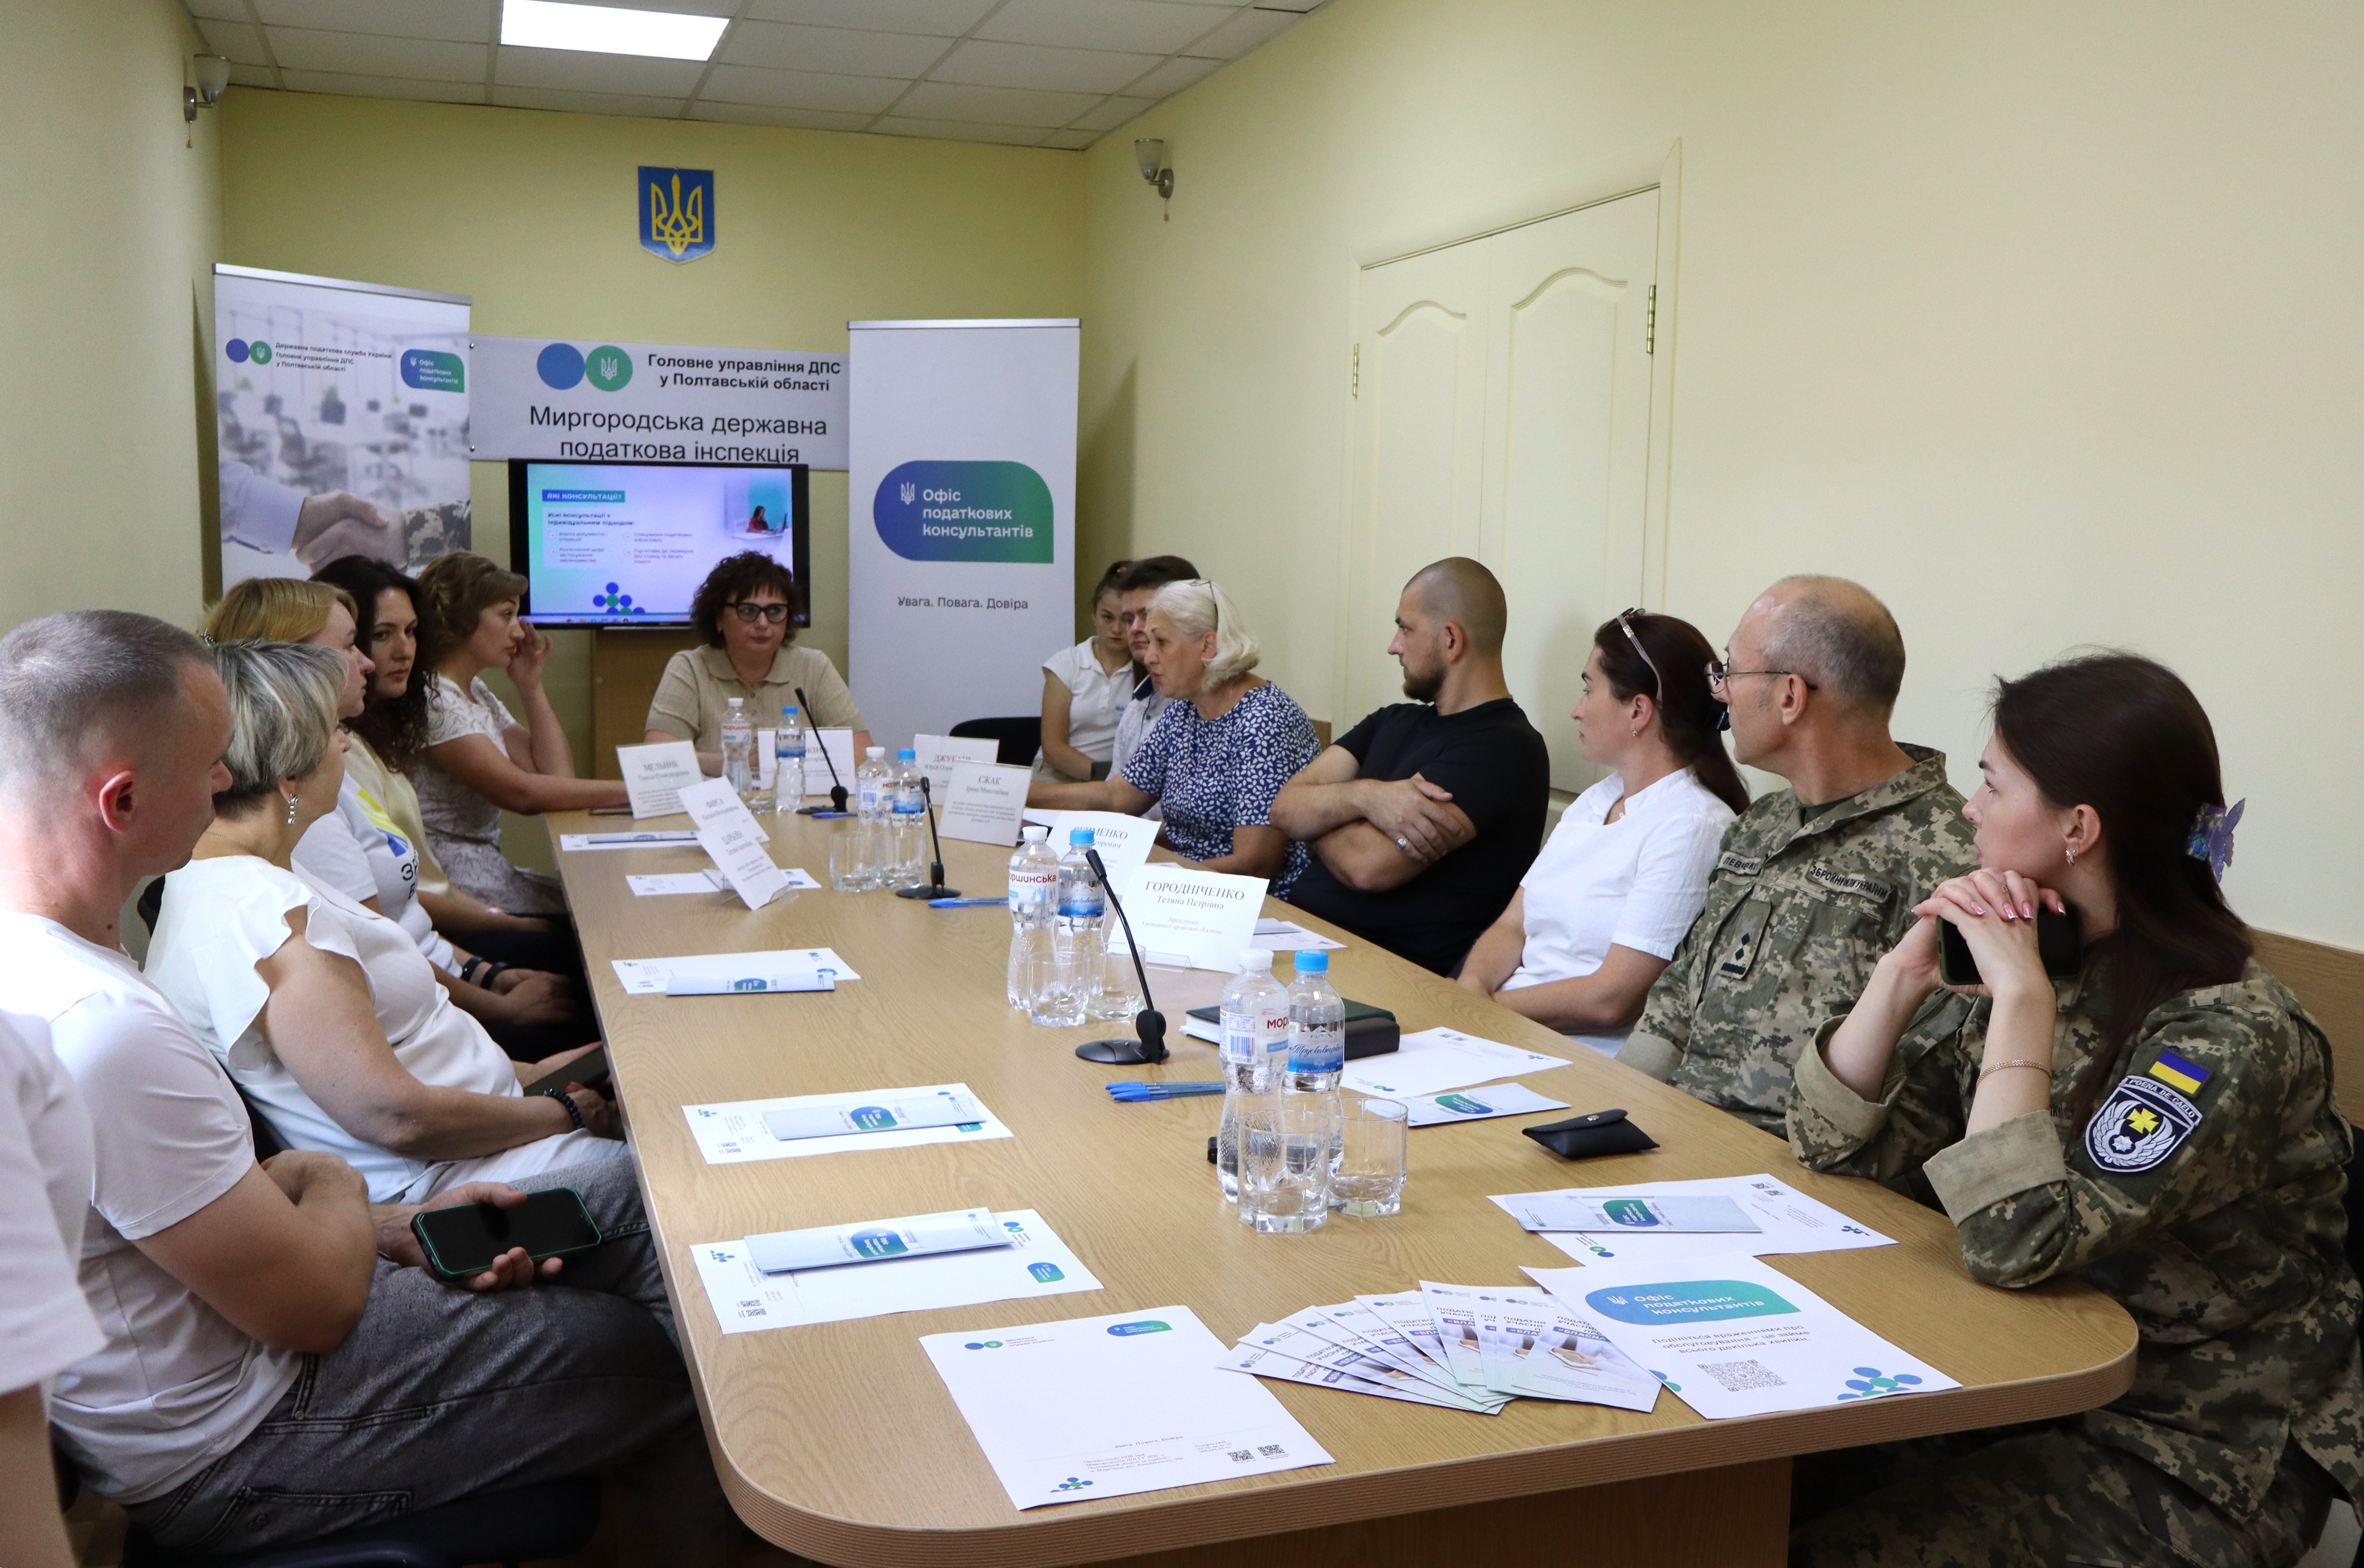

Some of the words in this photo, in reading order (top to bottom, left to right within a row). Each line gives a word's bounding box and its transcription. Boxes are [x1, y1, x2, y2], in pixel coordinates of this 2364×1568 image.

[276, 342, 308, 351] Державна
[282, 361, 321, 370] Полтавській
[648, 354, 713, 369] Головне
[718, 357, 804, 375] управління
[808, 361, 840, 375] ДПС
[659, 376, 667, 387] у
[674, 373, 769, 388] Полтавській
[773, 376, 829, 391] області
[530, 407, 703, 432] Миргородська
[711, 417, 826, 437] державна
[561, 440, 686, 460] податкова
[694, 441, 799, 463] інспекція
[922, 489, 961, 504] Офіс
[923, 506, 1012, 521] податкових
[923, 523, 1033, 539] консультантів
[898, 596, 933, 607] Увага.
[937, 597, 983, 608] Повага.
[987, 598, 1028, 610] Довіра
[966, 785, 979, 793] Ірина
[980, 787, 1009, 796] Миколаївна
[1074, 826, 1128, 839] МЕНКО
[1811, 866, 1843, 886] ЗБРОЙНІ
[1856, 879, 1889, 899] УКРАЇНИ
[1146, 881, 1244, 900] ГОРОДНІЧЕНКО
[1157, 895, 1184, 905] Тетяна
[1187, 898, 1224, 910] Петрівна
[1142, 920, 1172, 928] Громадської
[2129, 1079, 2159, 1094] POENA
[2159, 1088, 2172, 1100] DE
[2172, 1097, 2196, 1118] CAELO
[1643, 1296, 1736, 1308] податкових
[1651, 1301, 1765, 1315] консультантів
[1652, 1335, 1711, 1344] Поділіться
[1713, 1327, 1782, 1339] враженнями
[1662, 1337, 1750, 1349] обслуговування
[1719, 1341, 1766, 1351] декілька
